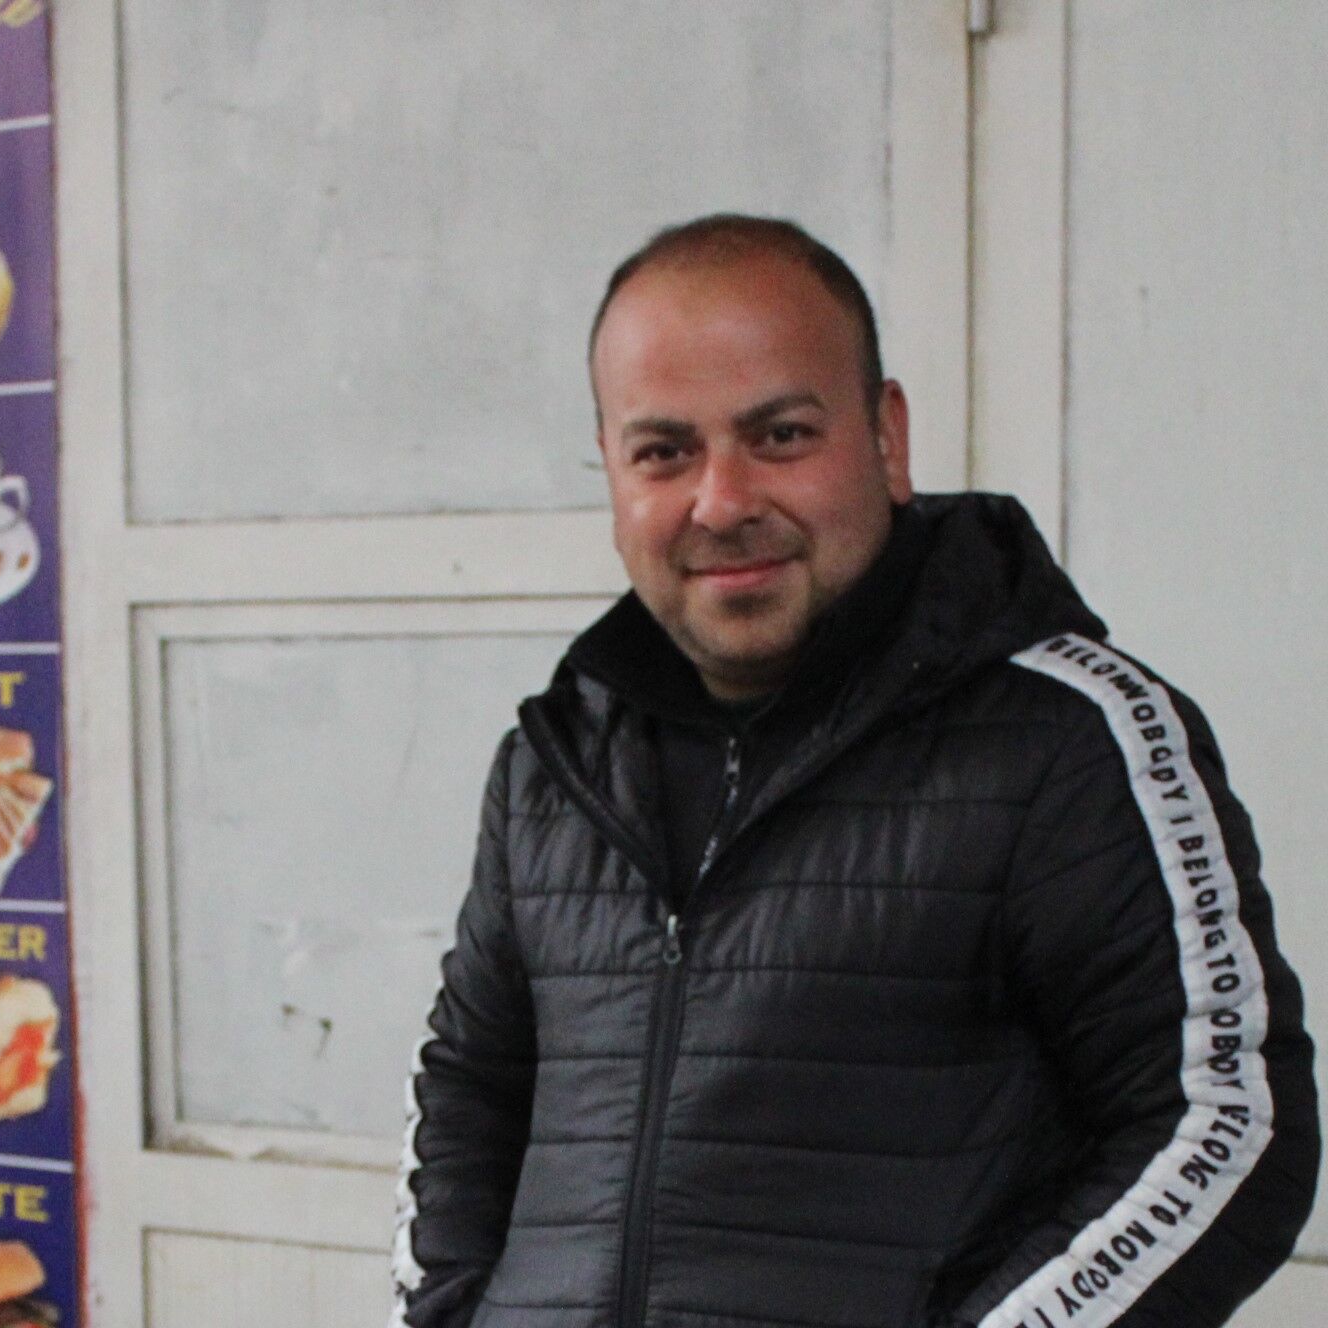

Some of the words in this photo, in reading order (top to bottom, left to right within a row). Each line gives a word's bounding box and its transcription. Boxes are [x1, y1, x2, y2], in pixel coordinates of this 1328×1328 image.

[1178, 834, 1228, 950] BELONG
[1206, 953, 1241, 994] TO
[1148, 1189, 1193, 1228] TO
